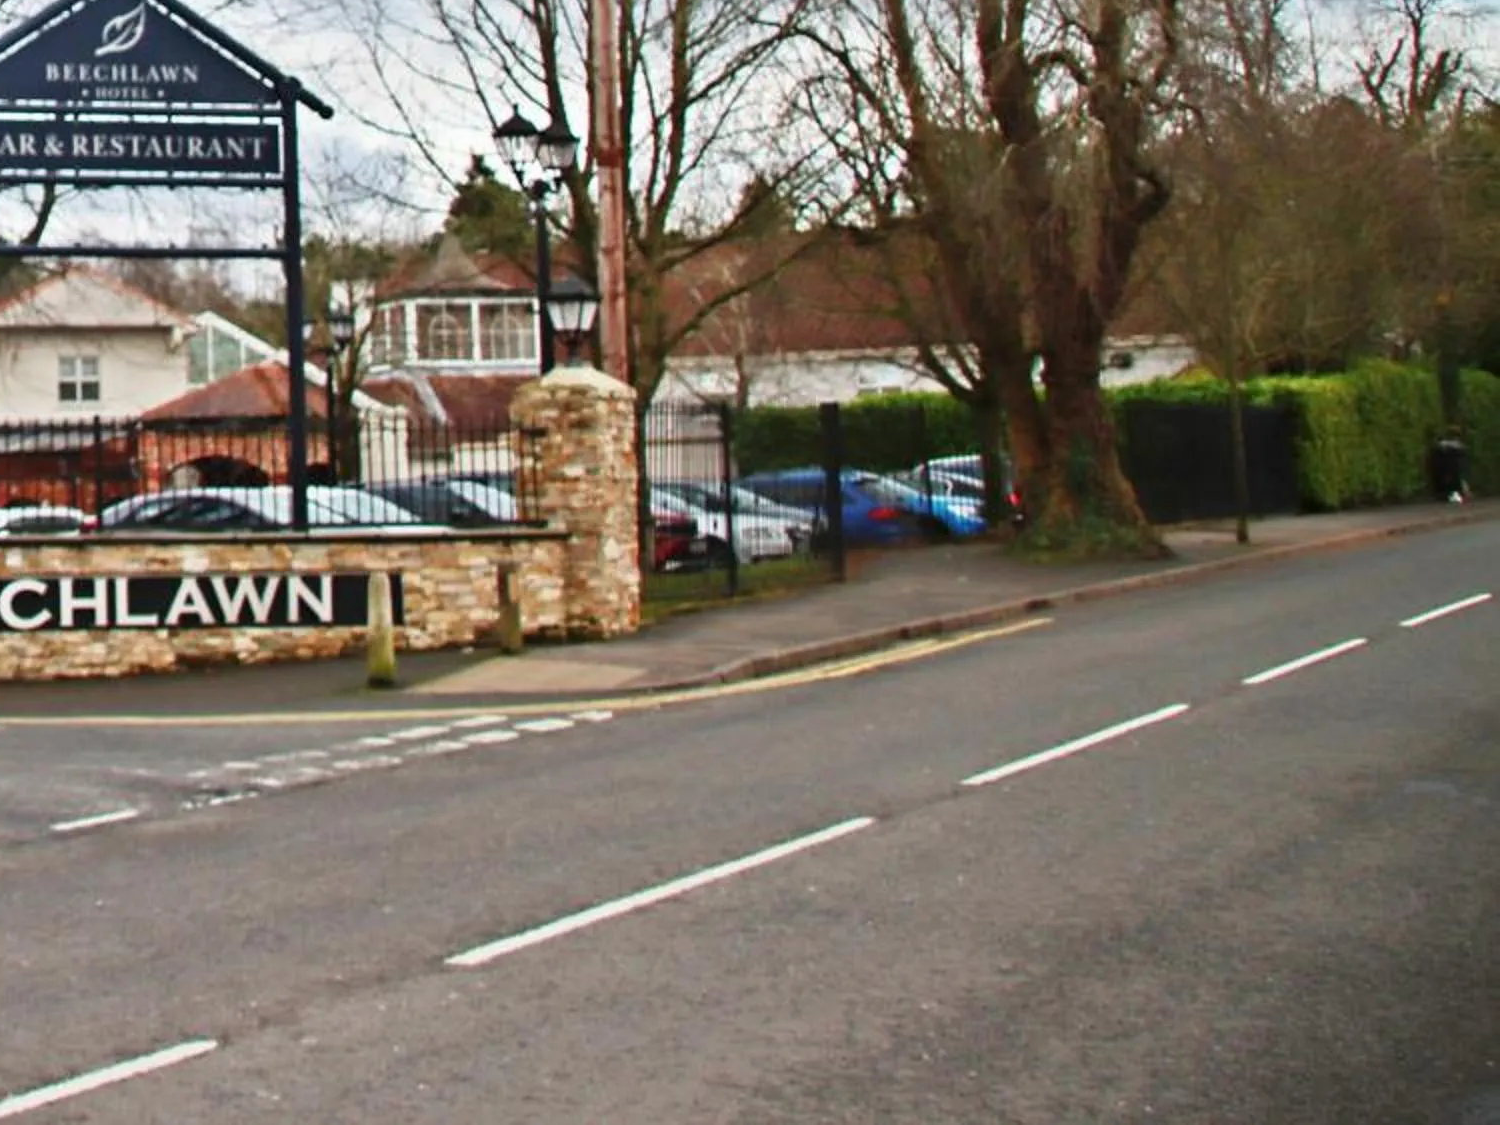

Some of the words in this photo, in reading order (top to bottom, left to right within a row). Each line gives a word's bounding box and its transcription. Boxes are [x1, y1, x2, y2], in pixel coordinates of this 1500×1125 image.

[45, 62, 200, 83] BEECHLAWN
[95, 86, 150, 99] HOTEL
[44, 134, 66, 157] &
[72, 132, 267, 160] RESTAURANT
